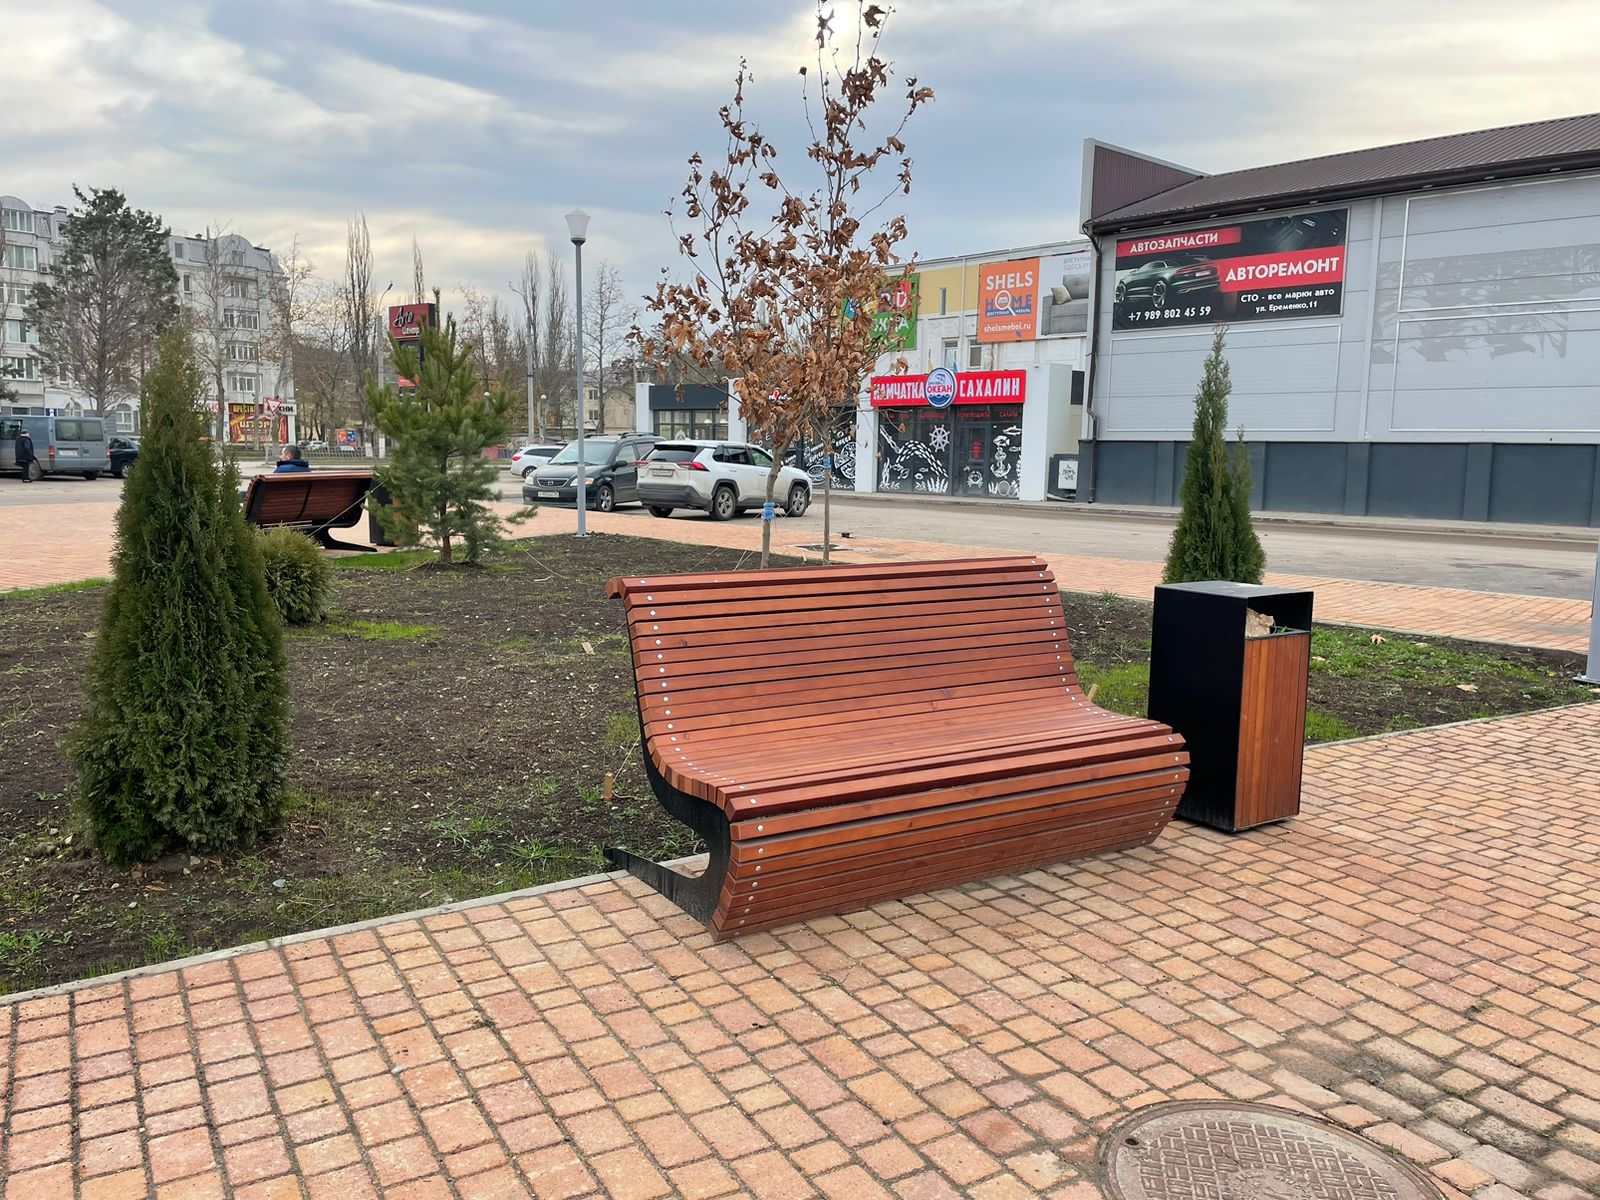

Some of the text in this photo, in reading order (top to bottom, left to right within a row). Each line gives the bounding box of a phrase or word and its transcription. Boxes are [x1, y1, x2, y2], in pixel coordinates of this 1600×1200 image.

[1130, 233, 1218, 253] АВТОЗАПЧАСТИ
[1225, 257, 1339, 282] АВТОРЕМОНТ
[985, 271, 1033, 291] SHELS
[1240, 293, 1259, 303] СТО
[1267, 292, 1282, 301] все
[1284, 290, 1313, 301] марки
[1314, 288, 1335, 298] авто
[1128, 306, 1212, 322] +7 989 802 45 59
[927, 384, 953, 394] ОКЕАН
[959, 378, 1020, 398] САХАЛИН
